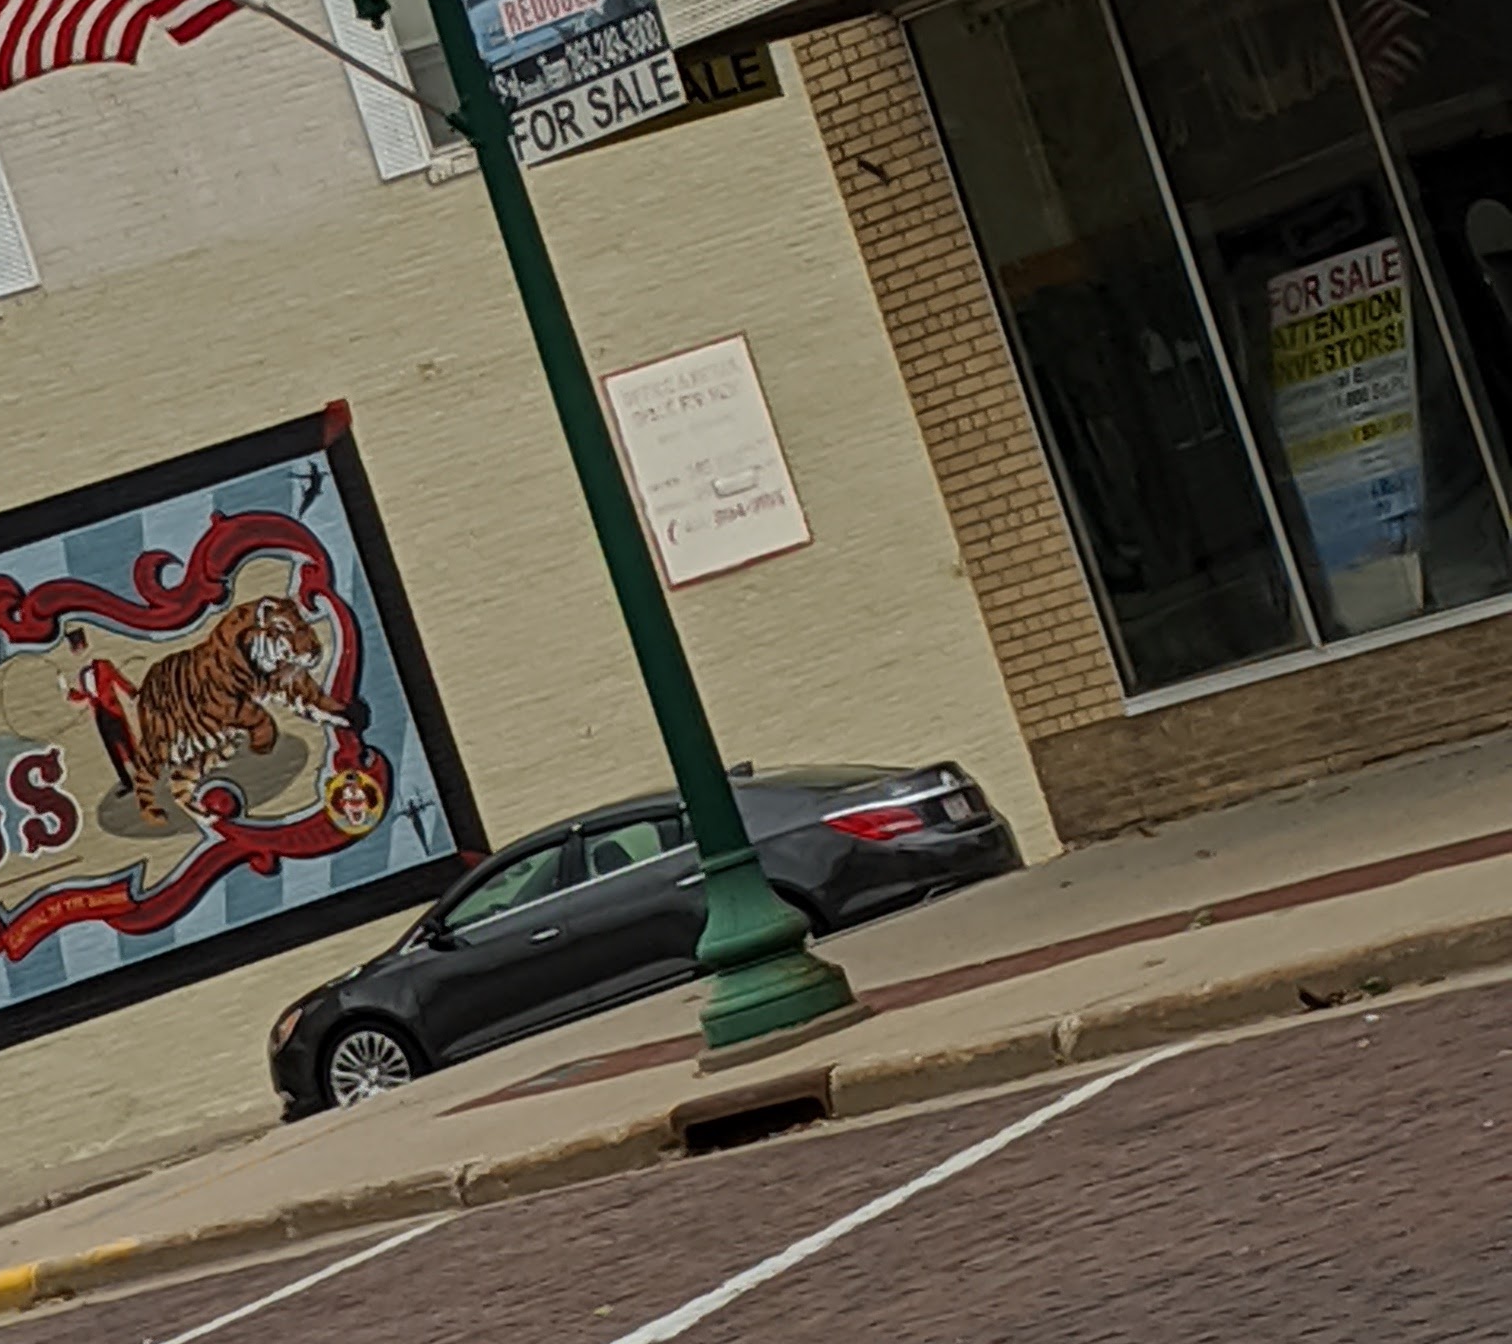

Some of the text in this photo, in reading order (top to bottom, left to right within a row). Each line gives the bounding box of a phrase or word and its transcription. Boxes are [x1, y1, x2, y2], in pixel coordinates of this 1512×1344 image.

[509, 99, 585, 162] FOR
[587, 57, 681, 130] SALE
[686, 48, 768, 105] ALE
[1268, 246, 1402, 316] FOR SALE
